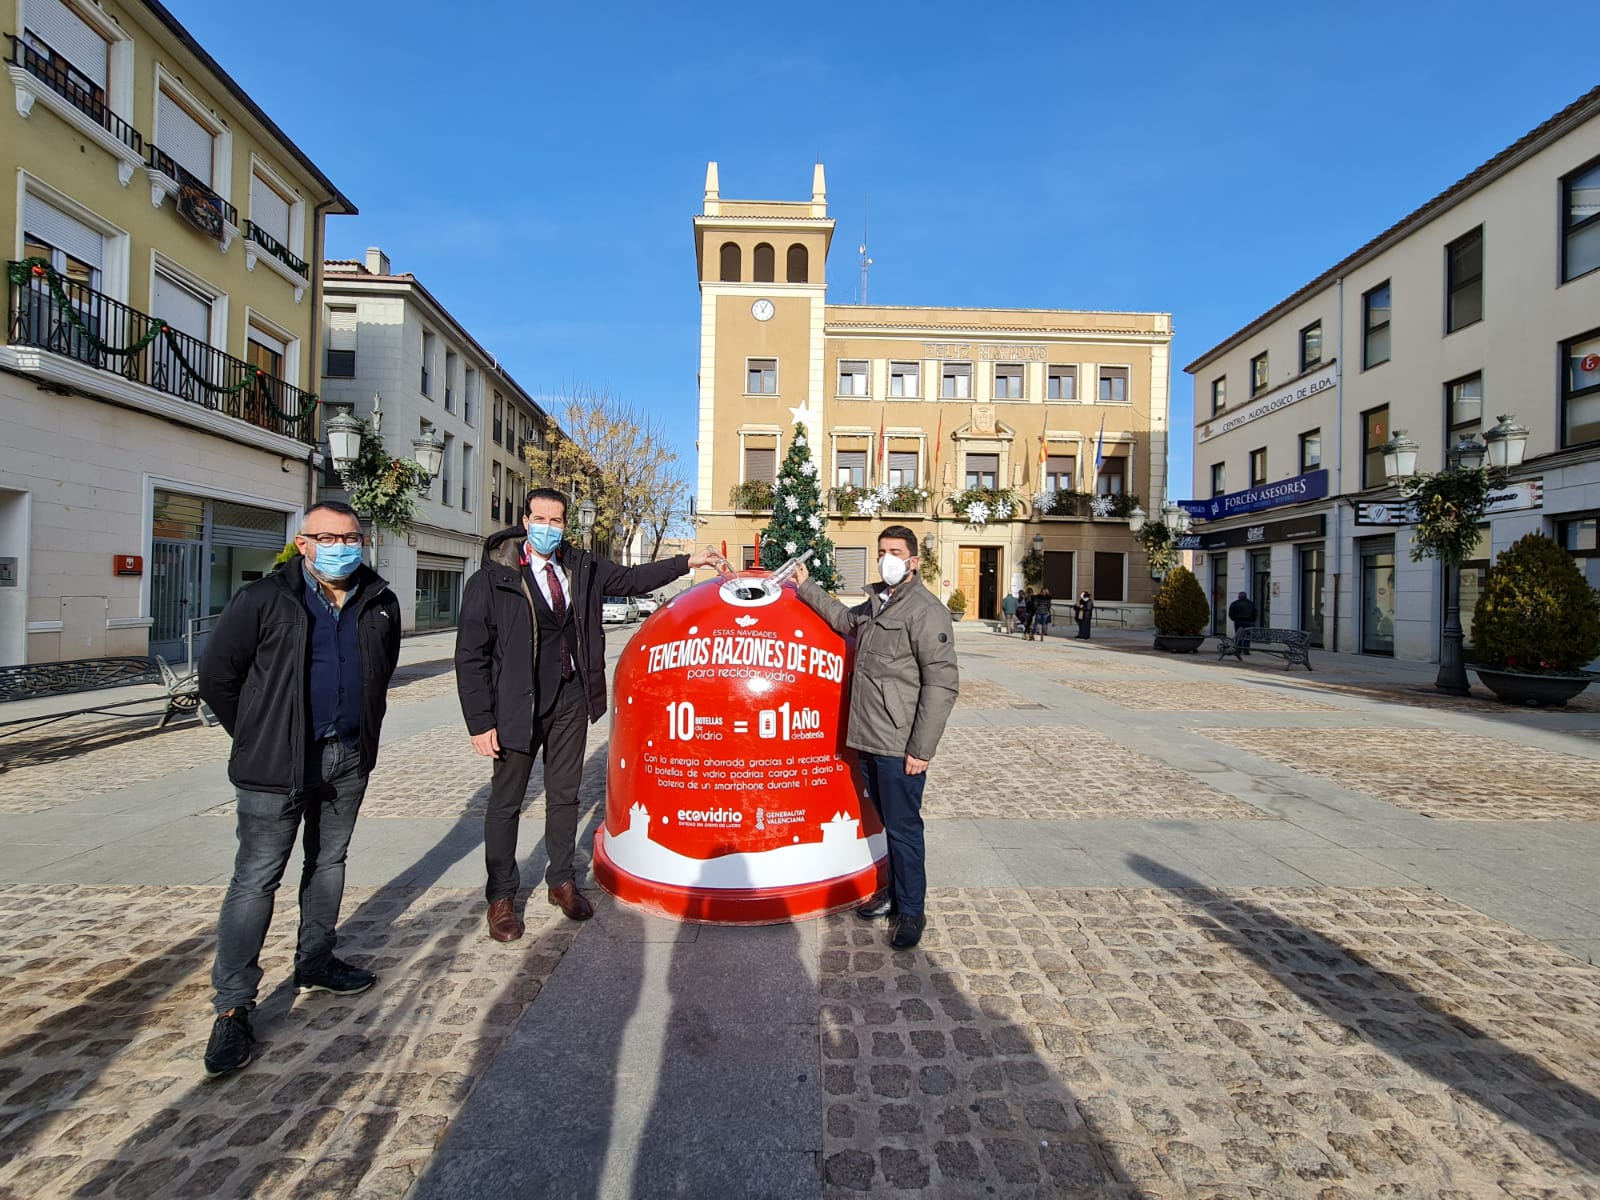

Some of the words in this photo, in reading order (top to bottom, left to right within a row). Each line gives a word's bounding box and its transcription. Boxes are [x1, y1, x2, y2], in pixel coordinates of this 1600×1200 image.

[1222, 415, 1246, 432] CENTRO
[1248, 394, 1294, 420] AUDIOLOGICO
[1297, 387, 1308, 399] DE
[1310, 377, 1333, 394] ELDA
[1260, 478, 1307, 501] ASESORES
[713, 629, 736, 637] ESTAS
[737, 629, 778, 639] NAVIDADES
[647, 636, 712, 674] TENEMOS
[712, 636, 785, 669] RAZONES
[786, 641, 808, 673] DE
[808, 645, 844, 684] PESO
[687, 668, 715, 681] para
[718, 666, 761, 679] reciclar
[764, 669, 796, 683] vidrio
[666, 701, 695, 741] 10
[695, 716, 723, 726] BOTELLAS
[778, 701, 791, 741] 1
[791, 707, 820, 730] AÑO
[695, 731, 723, 741] vidrio
[643, 752, 658, 763] Con
[659, 755, 667, 764] la
[703, 757, 745, 767] ahorrada
[749, 758, 783, 768] gracias
[785, 755, 795, 765] al
[797, 754, 831, 764] reciclaje
[654, 766, 683, 777] botellas
[687, 768, 698, 778] de
[702, 768, 727, 778] vidrio
[767, 769, 798, 779] cargar
[811, 765, 834, 775] diario
[836, 762, 844, 771] la
[687, 780, 698, 790] de
[701, 782, 711, 790] un
[713, 781, 764, 791] smartphone
[767, 780, 801, 790] durante
[677, 807, 743, 824] ecovidrio
[765, 809, 807, 819] GENERALITAT
[766, 815, 806, 825] VALENCIANA
